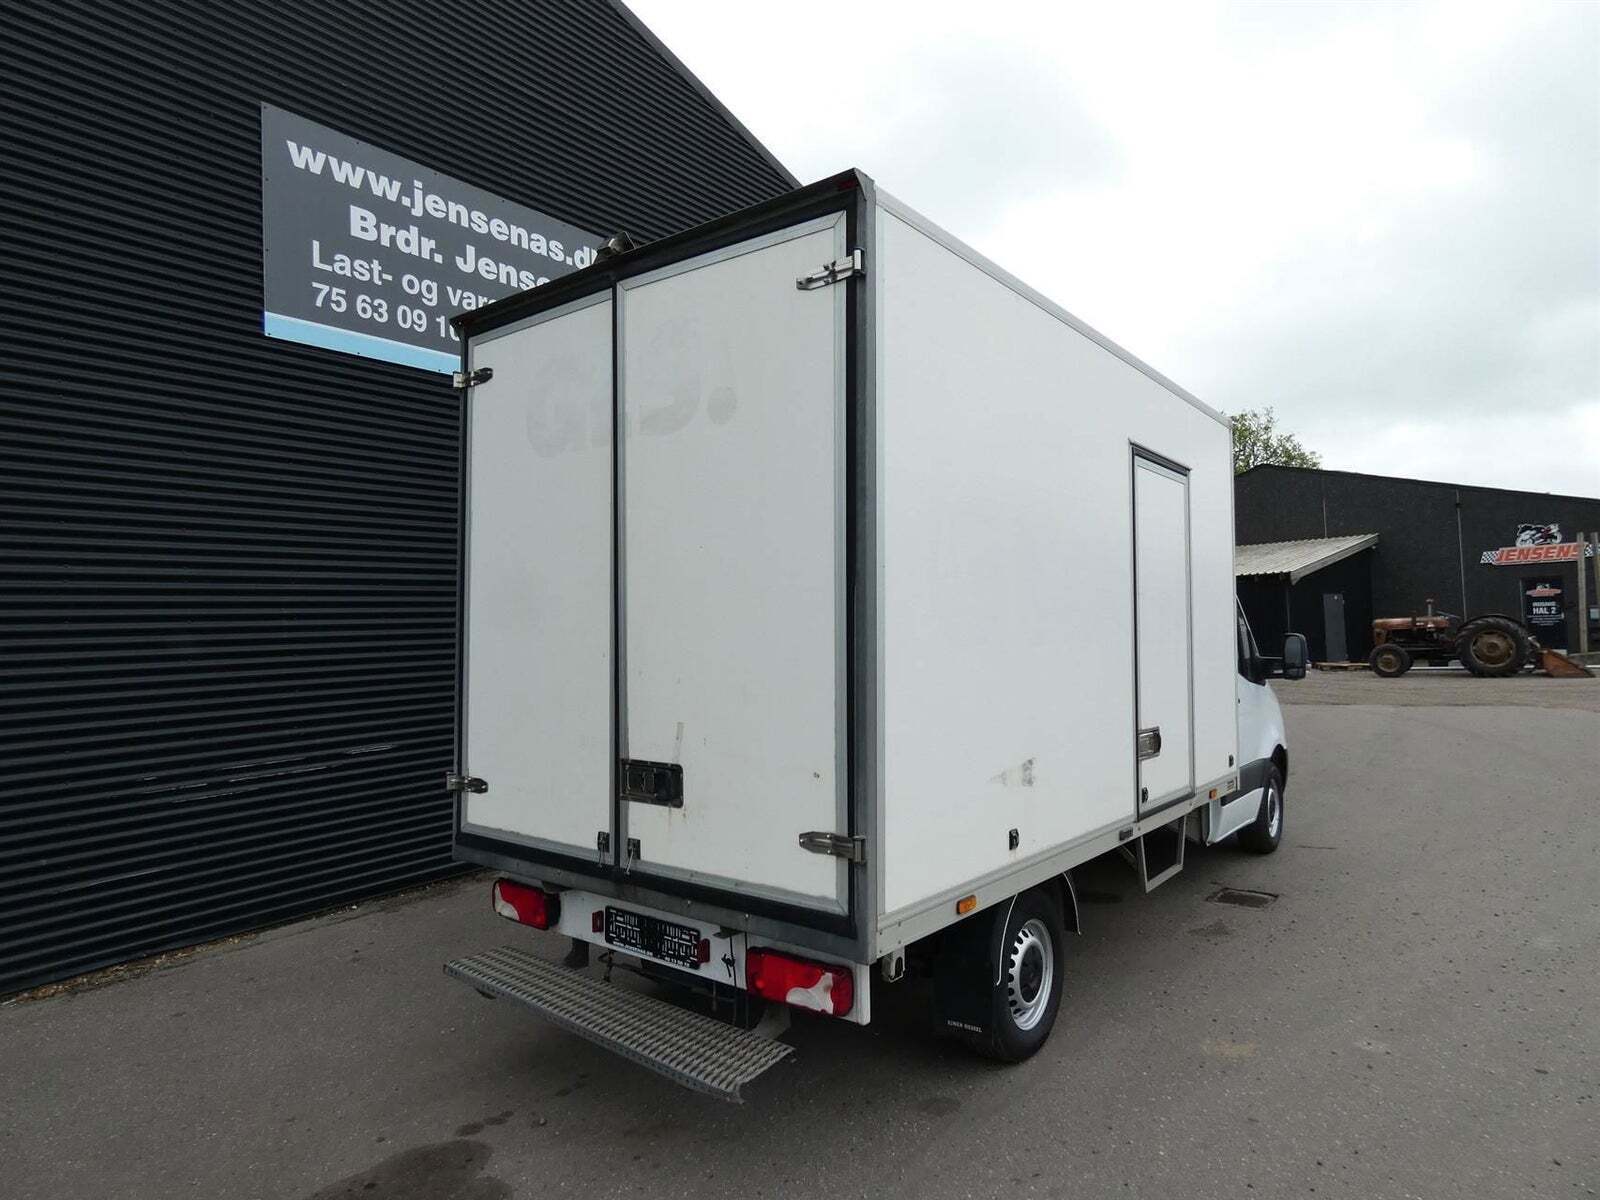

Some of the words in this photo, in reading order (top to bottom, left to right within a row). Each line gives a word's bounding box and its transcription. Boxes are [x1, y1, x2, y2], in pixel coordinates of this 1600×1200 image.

[350, 205, 443, 264] Brdr.
[312, 240, 393, 285] Last-
[402, 274, 438, 307] og
[447, 286, 497, 311] var
[312, 282, 347, 313] 75
[356, 294, 389, 323] 63
[397, 305, 428, 333] 09
[1533, 607, 1550, 615] HAL
[1551, 606, 1557, 615] 2
